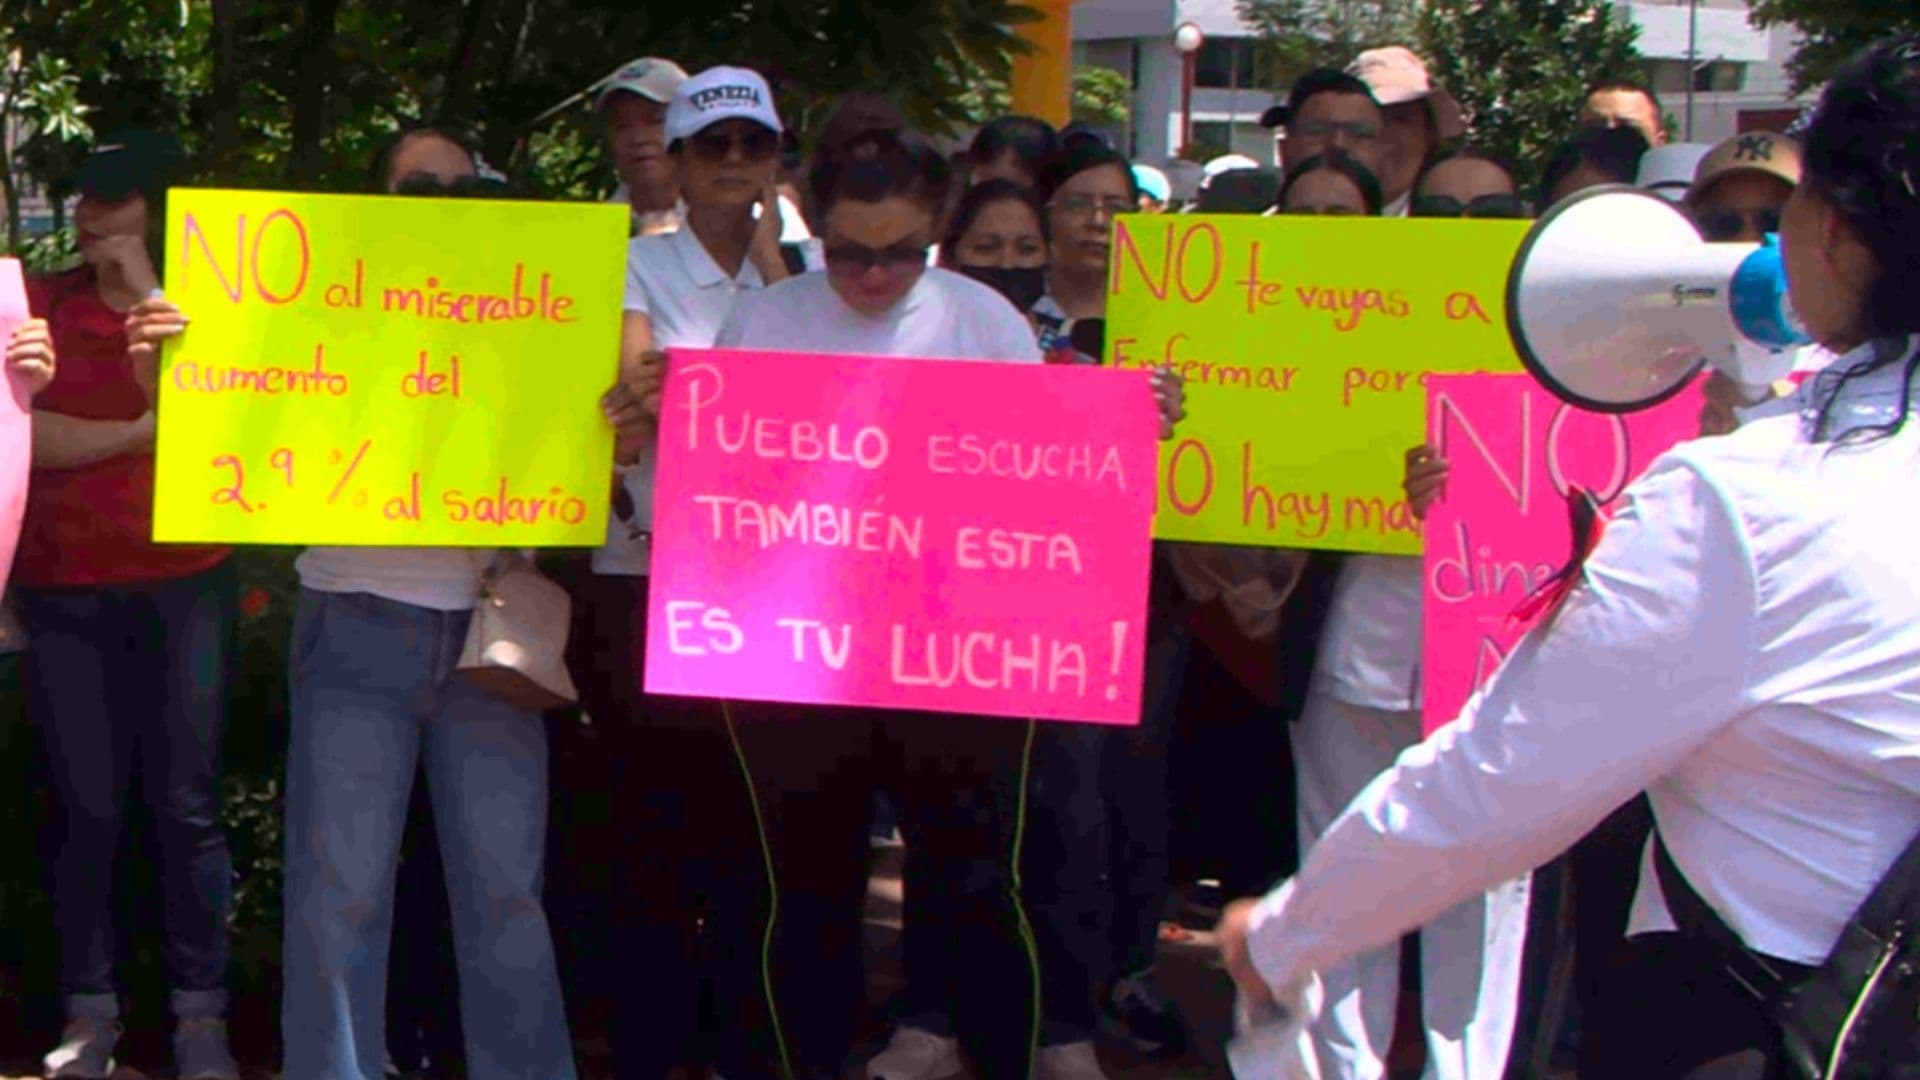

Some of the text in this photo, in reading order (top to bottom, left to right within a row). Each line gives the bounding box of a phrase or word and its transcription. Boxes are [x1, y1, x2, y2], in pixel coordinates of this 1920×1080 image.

[182, 209, 575, 324] NO al miserable
[1111, 221, 1492, 331] NO te vayas a
[174, 344, 461, 398] aumento del
[677, 363, 1126, 491] PUEBLO ESCUCHA
[1436, 391, 1630, 516] NO
[211, 448, 295, 512] 2.9
[384, 472, 421, 521] al
[443, 478, 587, 525] salario
[1150, 438, 1420, 539] O hay ma
[694, 494, 1082, 574] TAMBIÉN ESTA
[1432, 519, 1556, 603] dine
[665, 600, 745, 656] ES
[776, 618, 853, 670] TU
